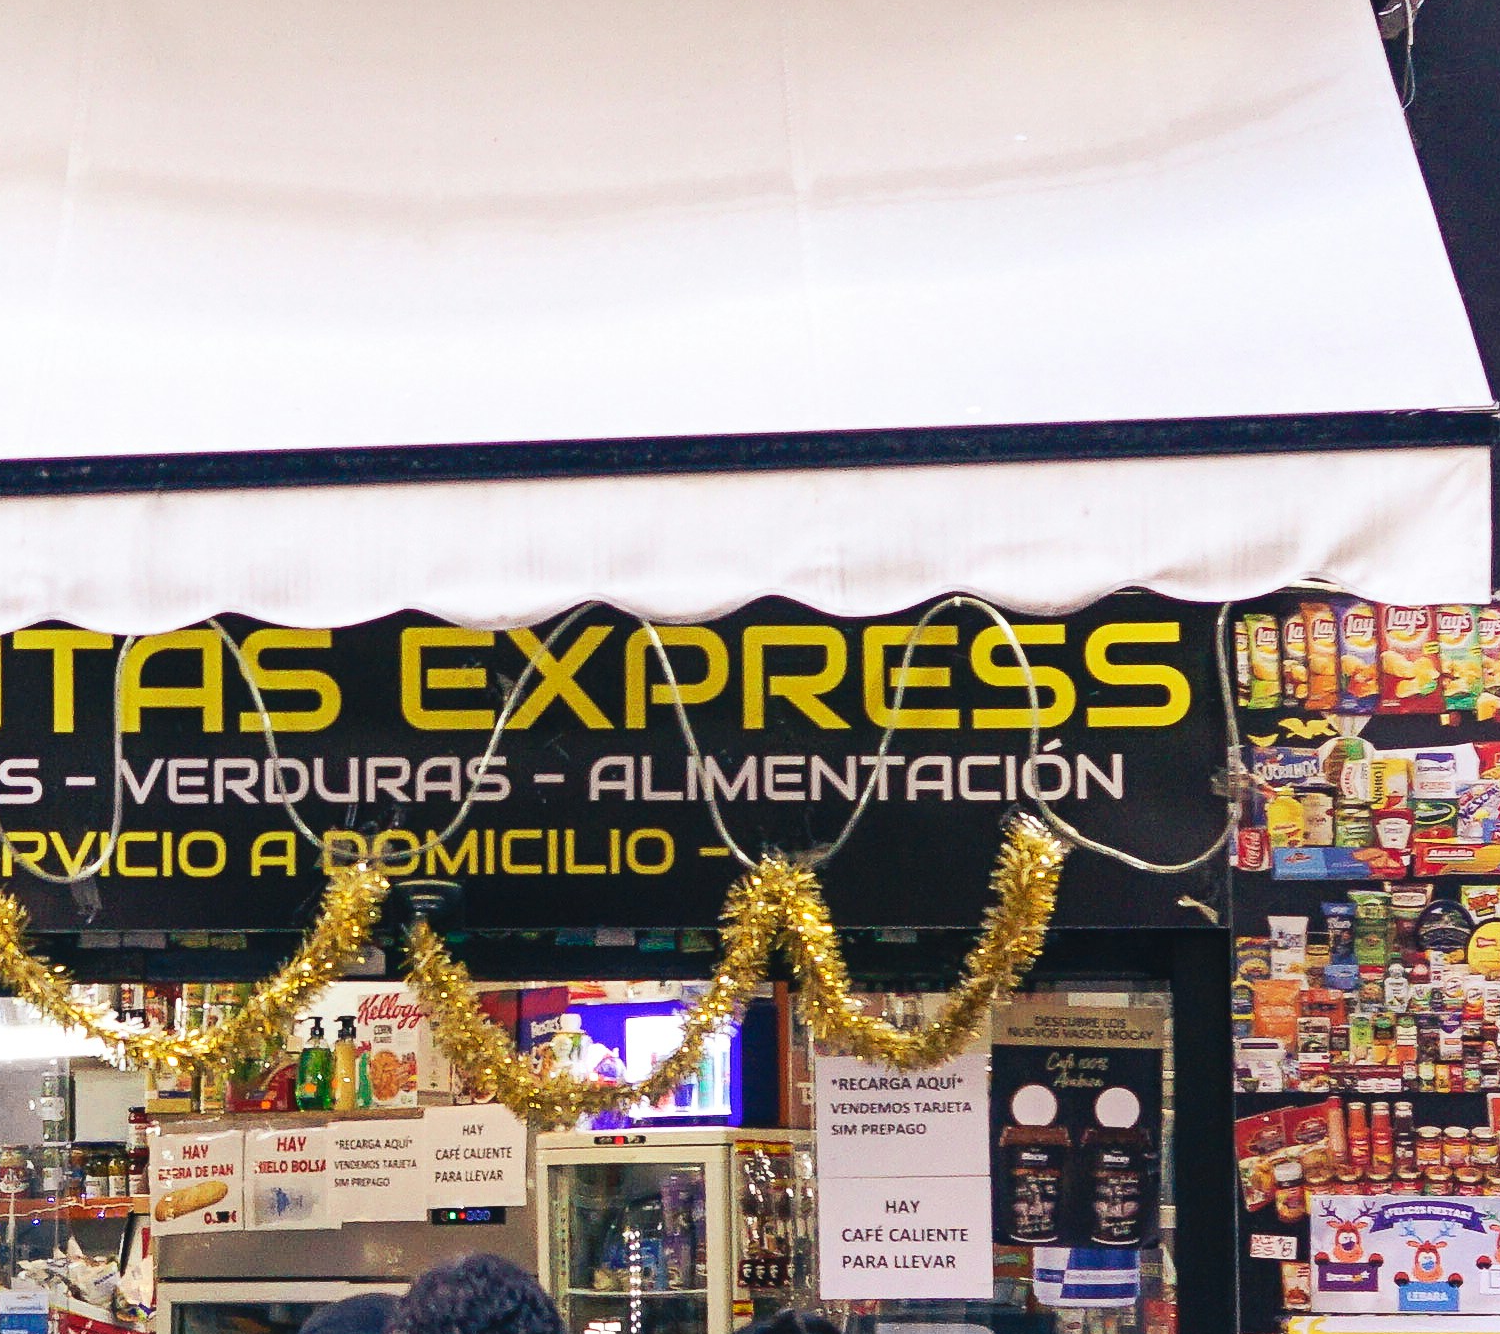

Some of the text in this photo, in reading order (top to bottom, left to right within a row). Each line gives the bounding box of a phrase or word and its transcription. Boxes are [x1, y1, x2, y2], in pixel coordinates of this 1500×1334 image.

[401, 621, 1192, 731] EXPRESS
[118, 755, 511, 805] VERDURAS
[589, 738, 1125, 802] ALIMENTACIÓN
[251, 830, 298, 877] A
[322, 827, 675, 877] DOMICILIO
[830, 1101, 972, 1114] VENDEMOS TARJETA
[462, 1123, 484, 1138] HAY
[831, 1122, 928, 1136] SIM PREPAGO
[183, 1144, 209, 1159] HAY
[276, 1136, 307, 1152] HAY
[435, 1145, 512, 1161] CAFÉ CALIENTE
[195, 1164, 235, 1179] DE PAN
[291, 1158, 327, 1174] BOLSA
[434, 1168, 503, 1184] PARA LLEVAR
[885, 1199, 920, 1215] HAY
[841, 1225, 969, 1243] CAFÉ CALIENTE
[842, 1254, 956, 1270] PARA LLEVAR
